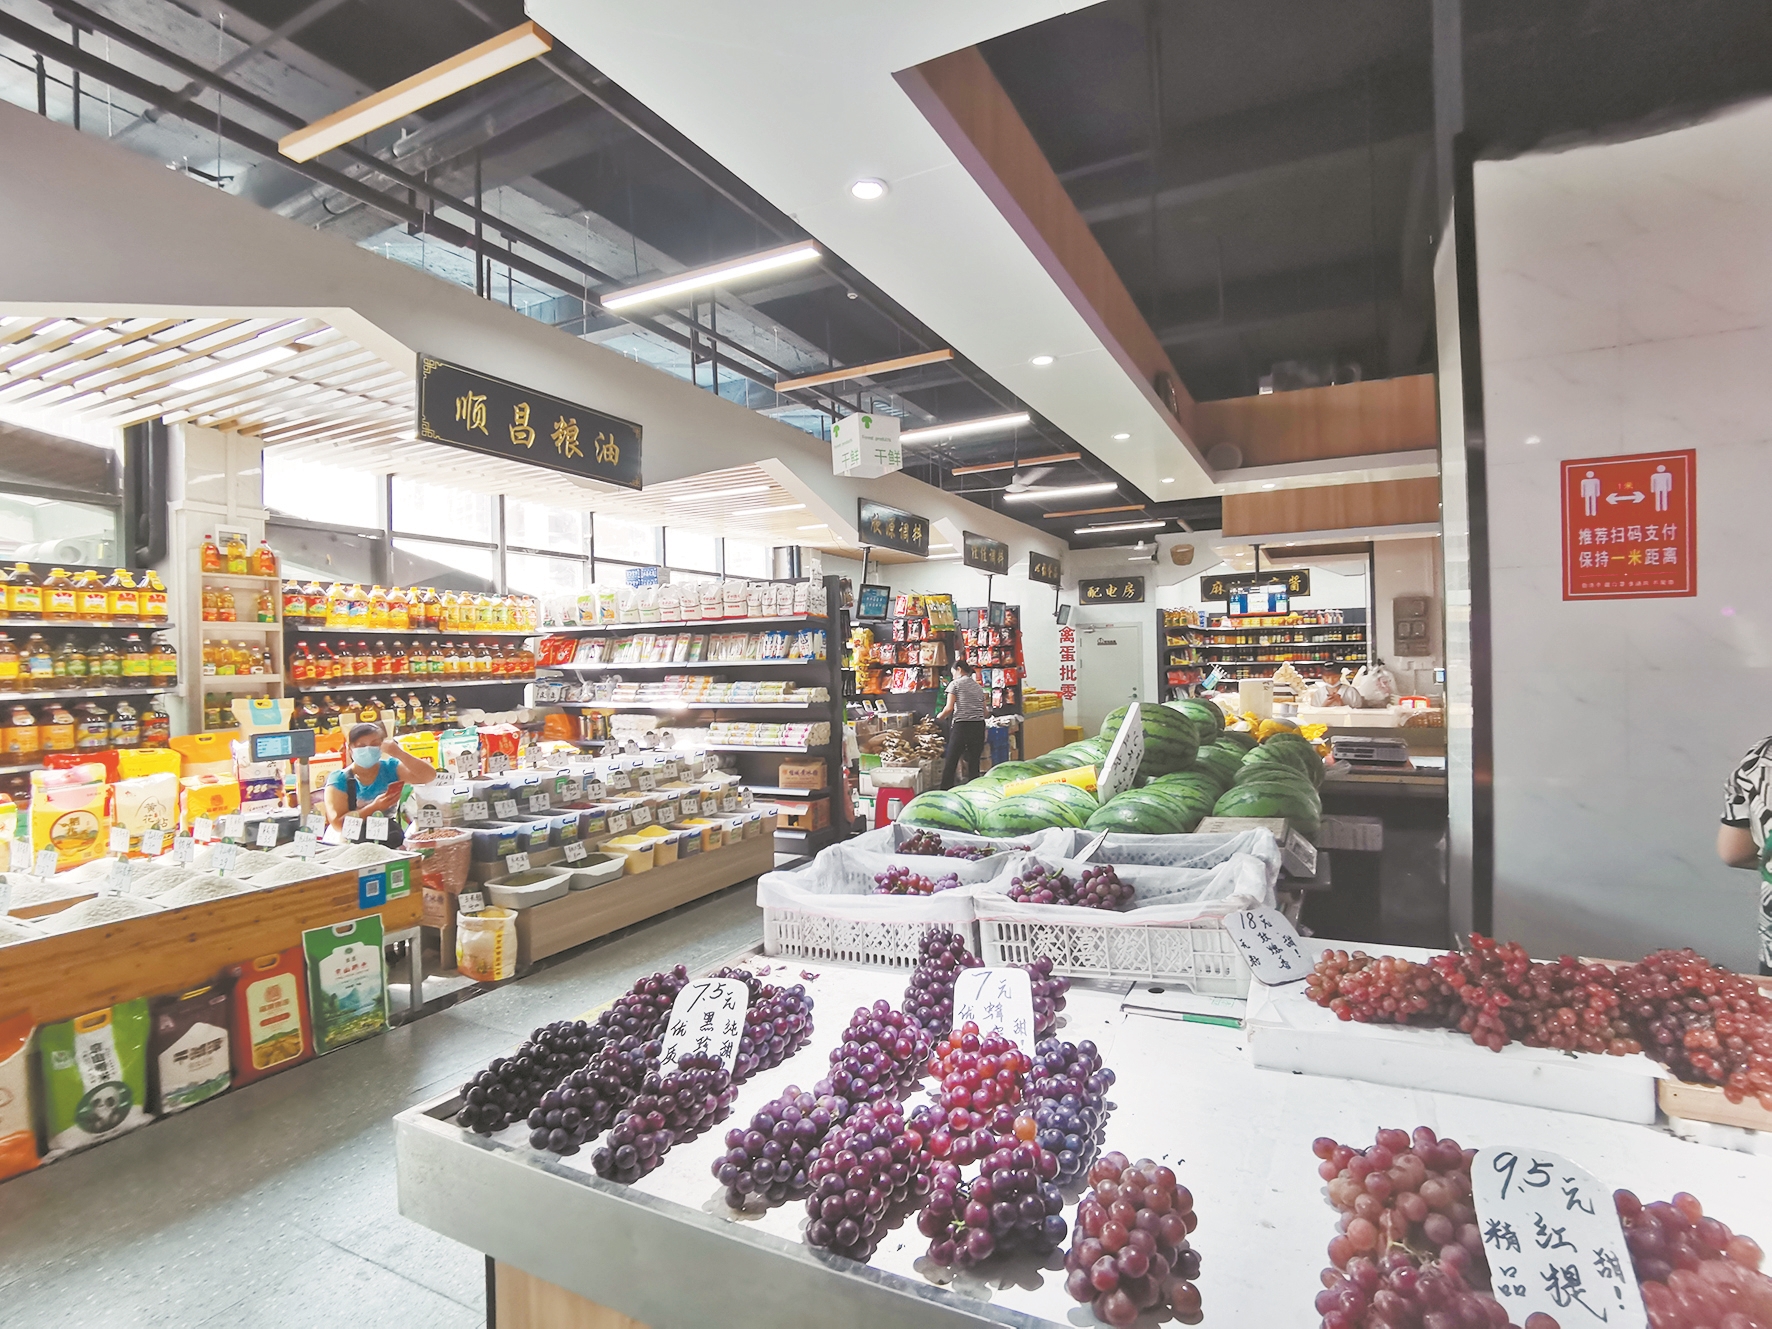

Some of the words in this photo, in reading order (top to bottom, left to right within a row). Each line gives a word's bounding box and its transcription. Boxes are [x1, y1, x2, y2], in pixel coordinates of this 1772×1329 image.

[455, 390, 621, 466] 顺昌粮油
[841, 449, 860, 468] 干鲜
[874, 448, 901, 466] 干鲜
[1578, 523, 1678, 545] 推荐扫码支付
[1578, 547, 1678, 568] 保持一米距离
[1087, 582, 1136, 599] 配电房
[1058, 625, 1077, 701] 禽蛋批零
[1240, 911, 1273, 930] 18元
[687, 982, 736, 1013] 7.5元
[971, 971, 1012, 1001] 7元
[1493, 1151, 1596, 1216] 9.5元
[1484, 1217, 1528, 1298] 精品
